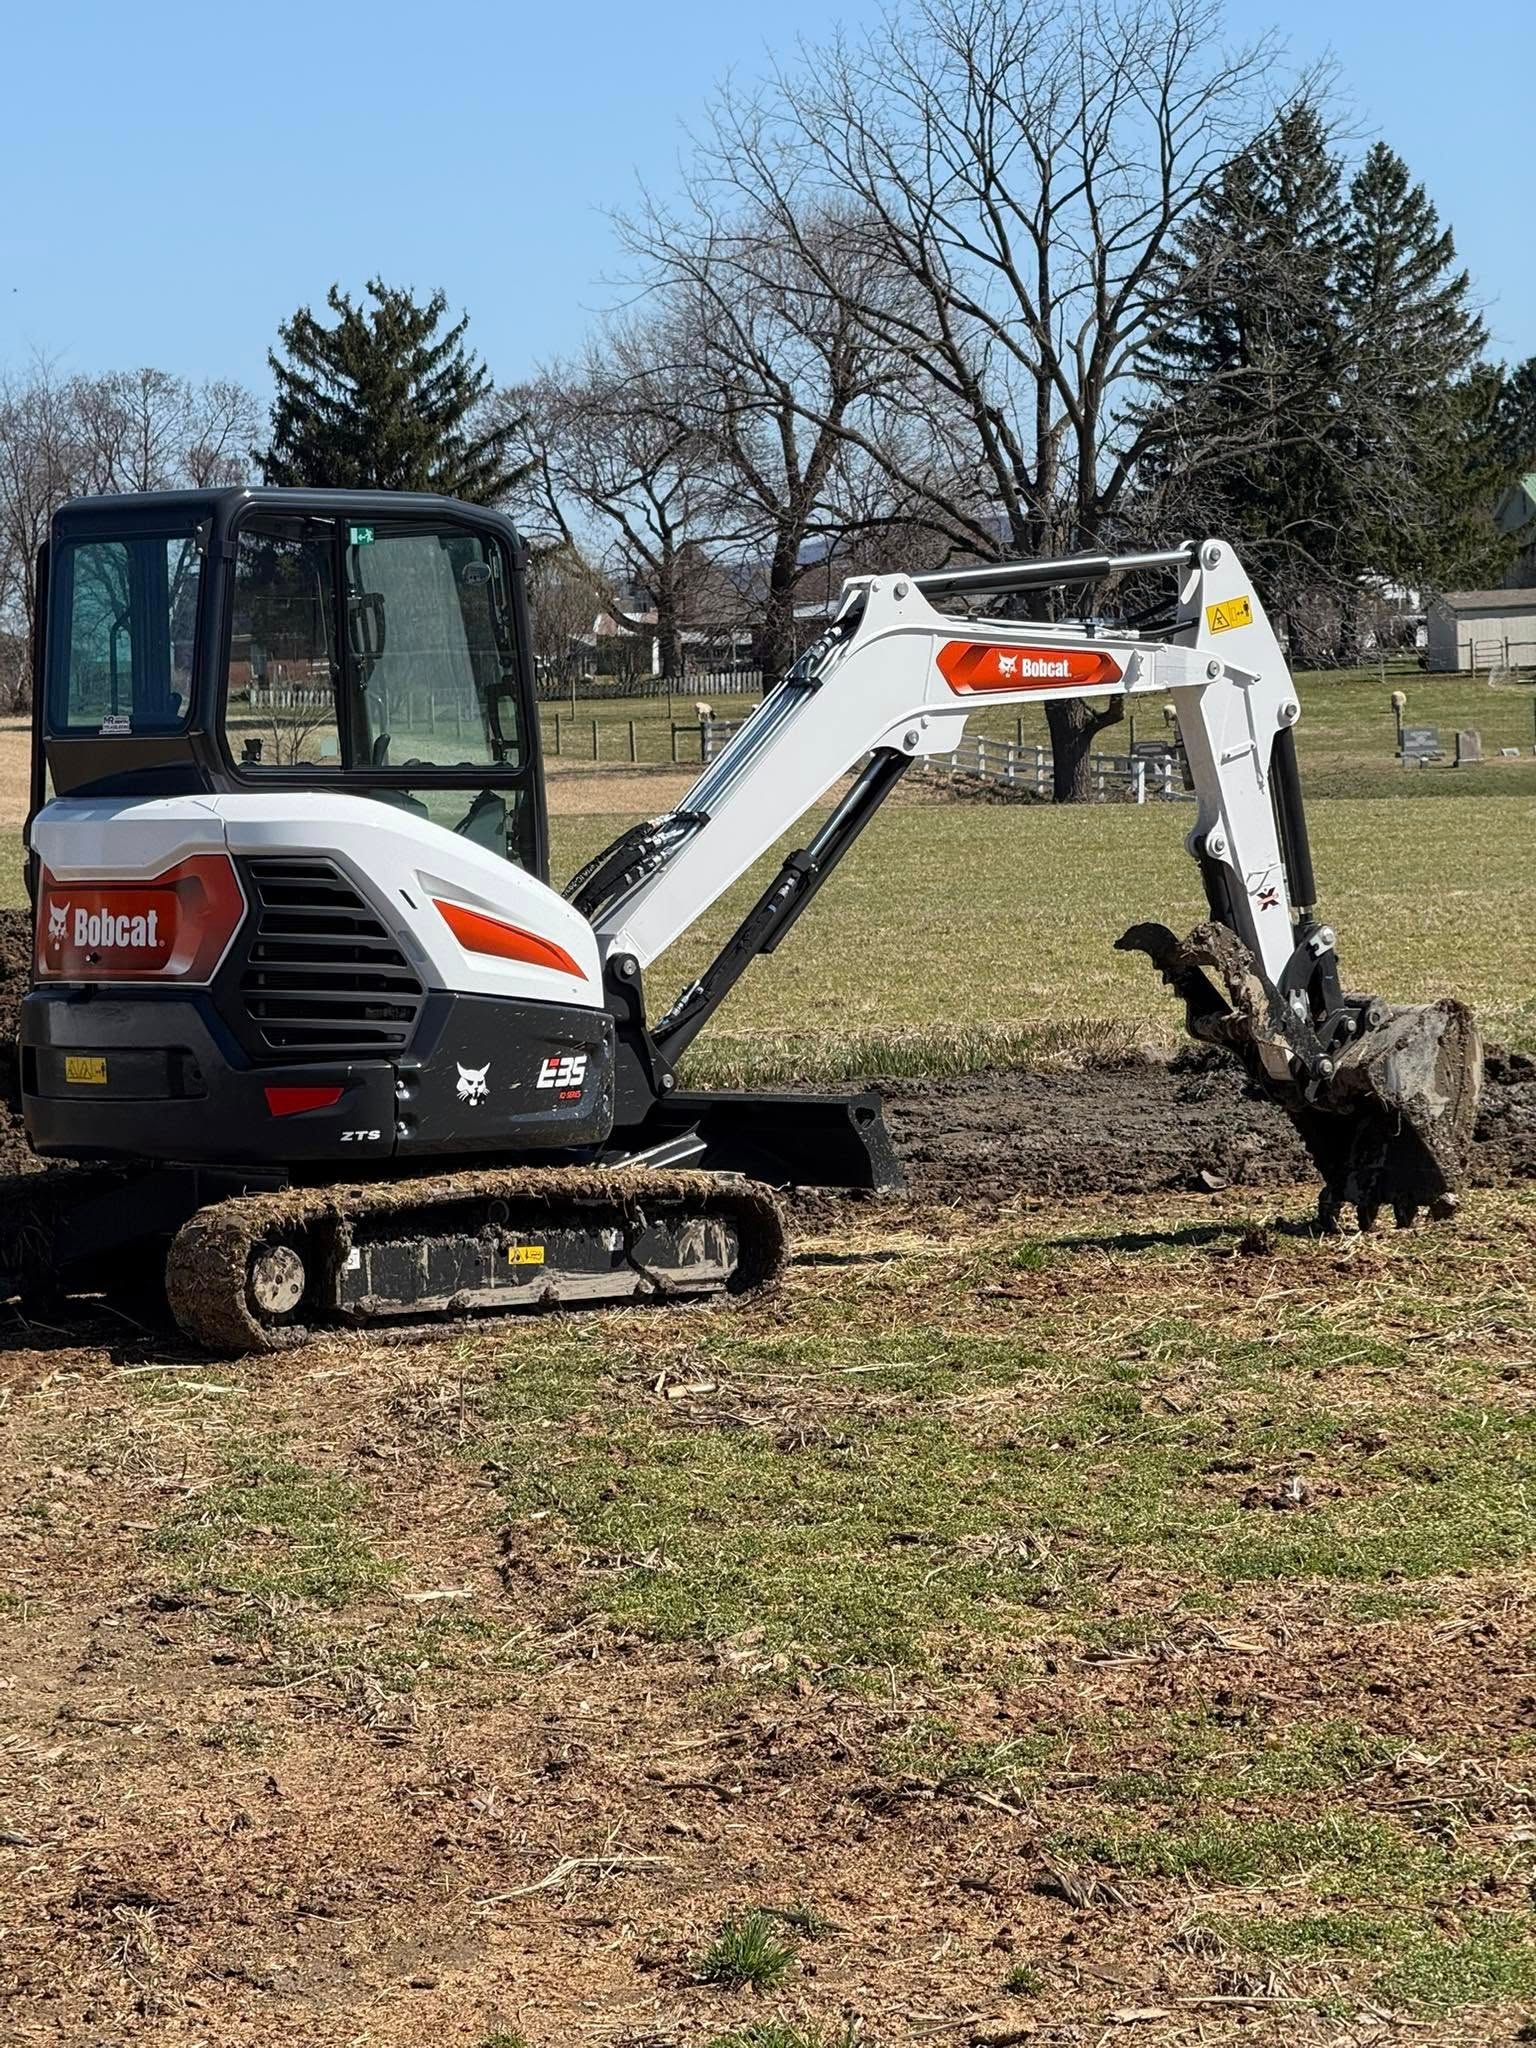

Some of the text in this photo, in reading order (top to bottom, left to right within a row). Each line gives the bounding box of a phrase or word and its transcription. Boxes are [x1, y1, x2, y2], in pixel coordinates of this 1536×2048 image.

[1022, 658, 1069, 677] Bobcat
[74, 907, 159, 948] Bobcat
[536, 1056, 588, 1089] E35
[340, 1129, 381, 1142] ZTS
